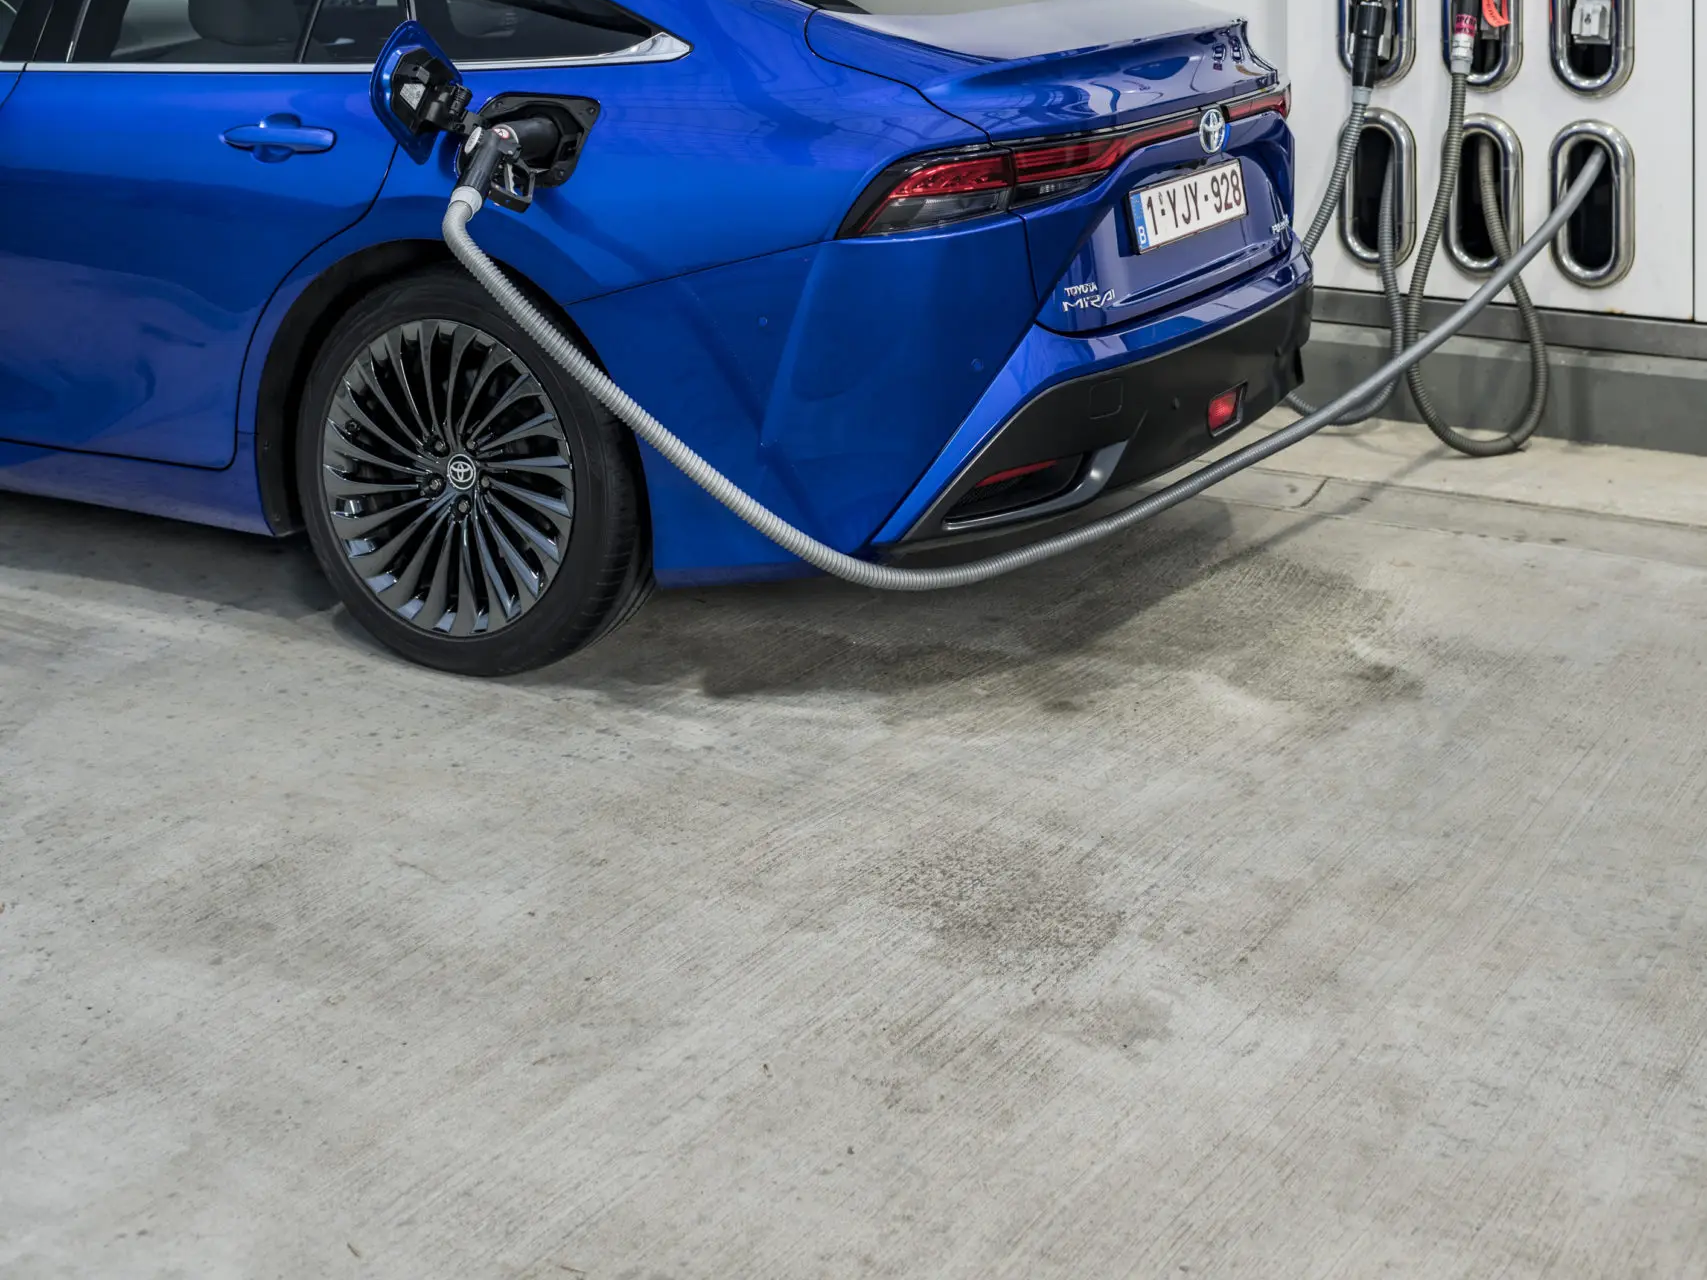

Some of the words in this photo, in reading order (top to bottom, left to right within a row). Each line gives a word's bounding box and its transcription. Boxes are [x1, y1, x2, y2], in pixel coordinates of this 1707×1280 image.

[1137, 226, 1148, 245] B
[1064, 281, 1098, 297] TOYOTA
[1062, 288, 1116, 312] MIRAI
